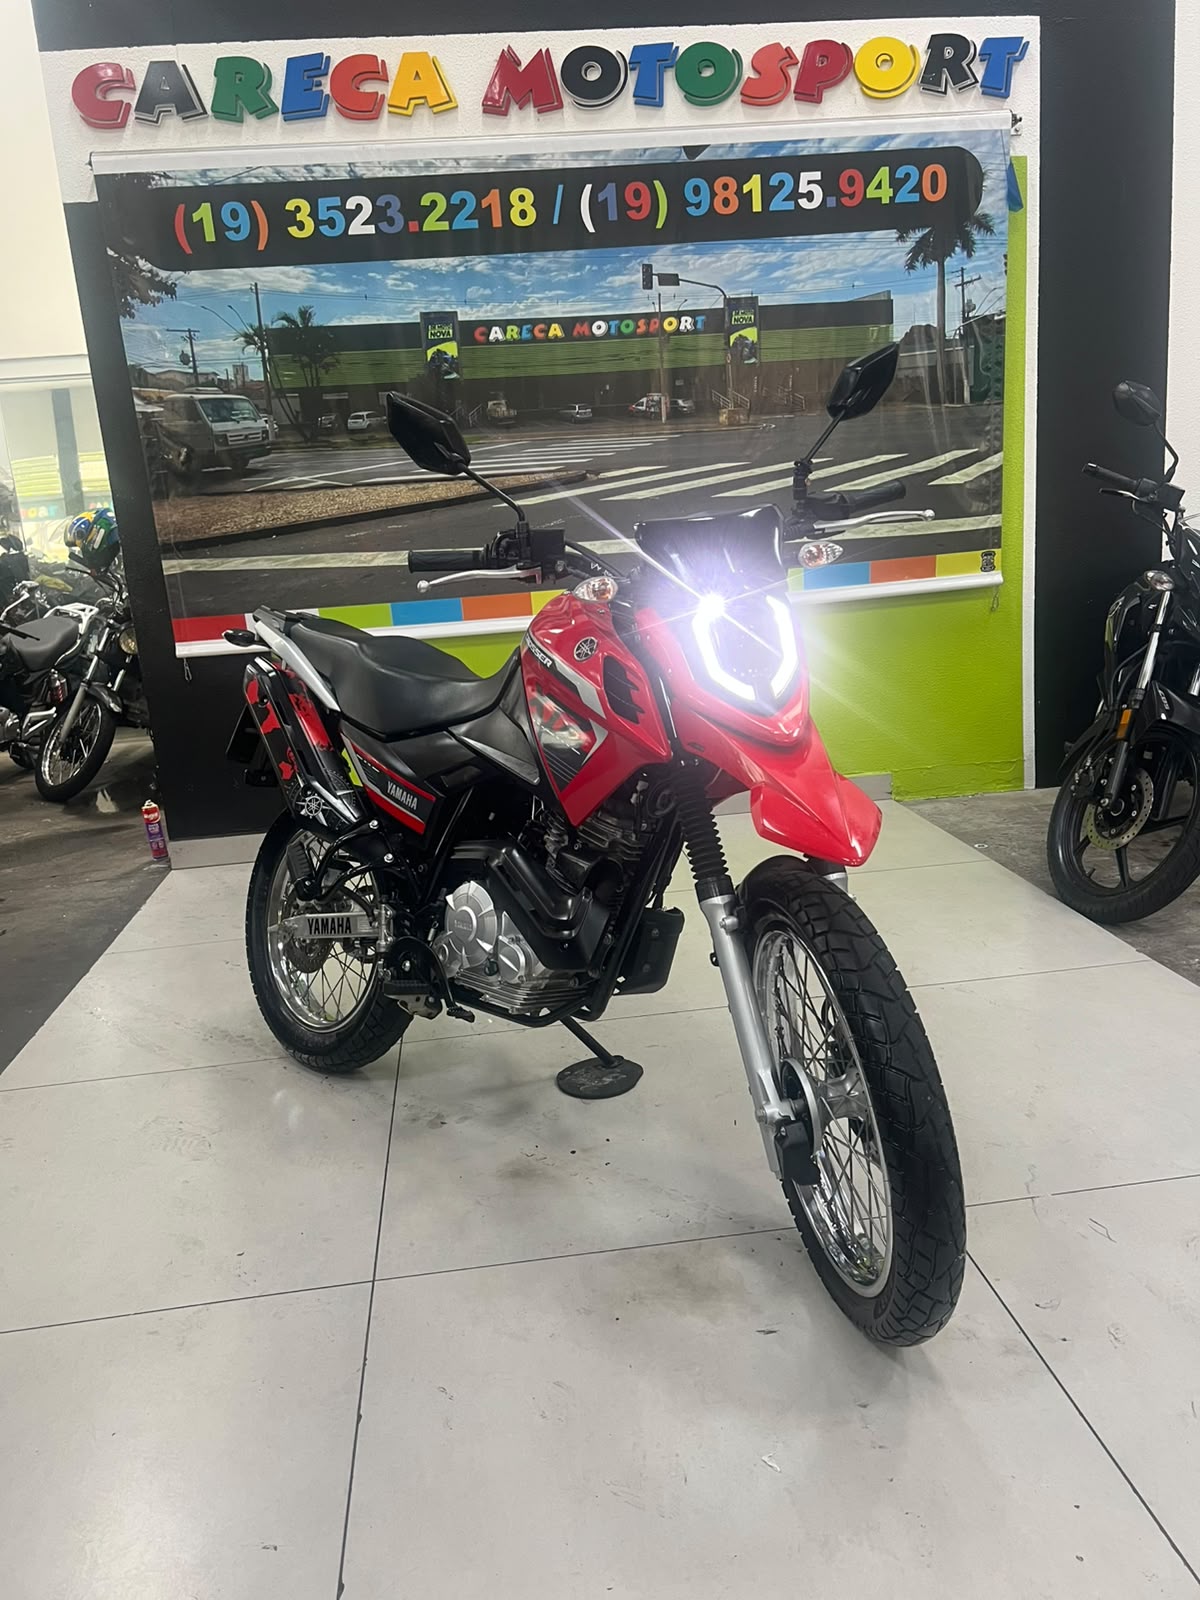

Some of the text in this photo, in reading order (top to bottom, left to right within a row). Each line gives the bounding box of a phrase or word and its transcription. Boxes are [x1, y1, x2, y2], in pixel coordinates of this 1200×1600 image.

[71, 33, 1029, 129] CARECA MOTOSPORT
[173, 163, 949, 255] (19) 3523.2218 / (19) 98125.9420
[430, 330, 451, 338] NOVA
[473, 315, 706, 342] CARECA MOTOSPORT
[387, 781, 418, 810] YAMAHA
[307, 917, 352, 935] YAMAHA
